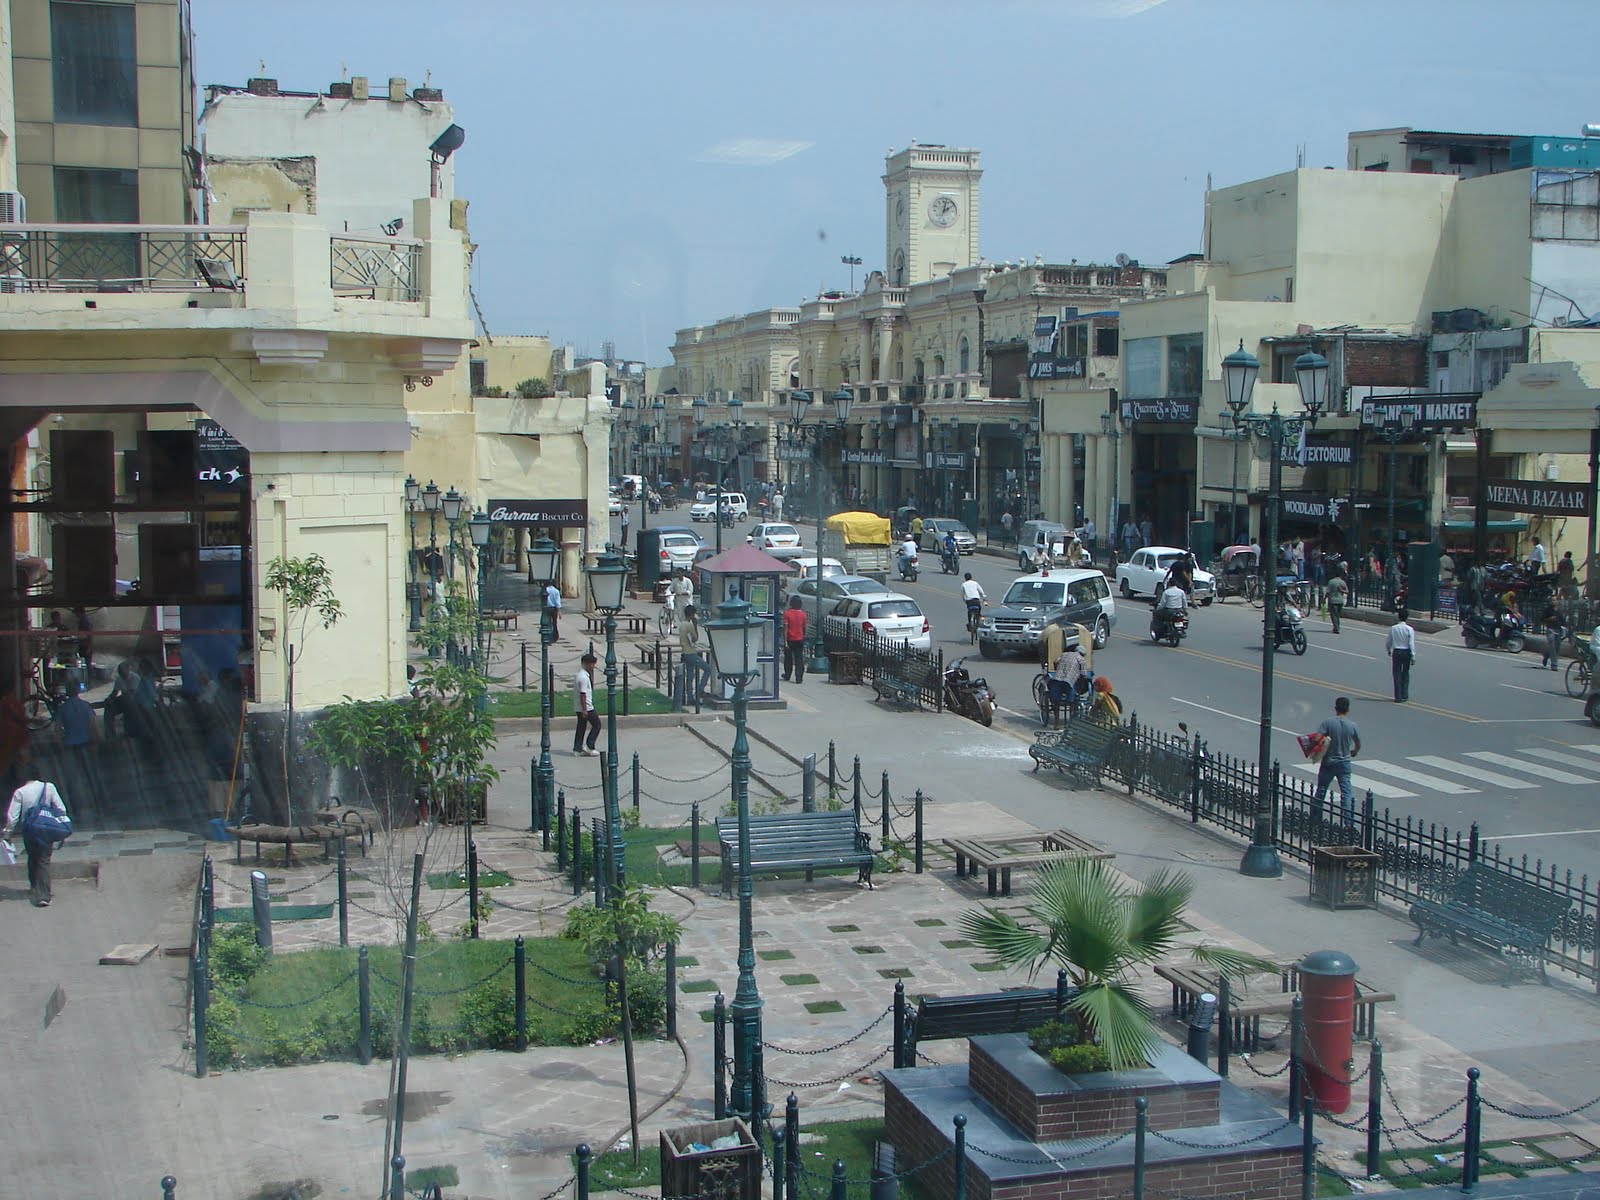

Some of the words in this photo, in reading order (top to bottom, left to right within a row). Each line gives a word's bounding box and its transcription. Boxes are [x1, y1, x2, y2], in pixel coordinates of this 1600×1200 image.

[1426, 403, 1472, 420] MARKET
[1487, 485, 1528, 505] MEENA
[1532, 489, 1584, 509] BAZAAR
[490, 506, 540, 521] Burma
[1284, 500, 1324, 516] WOODLAND
